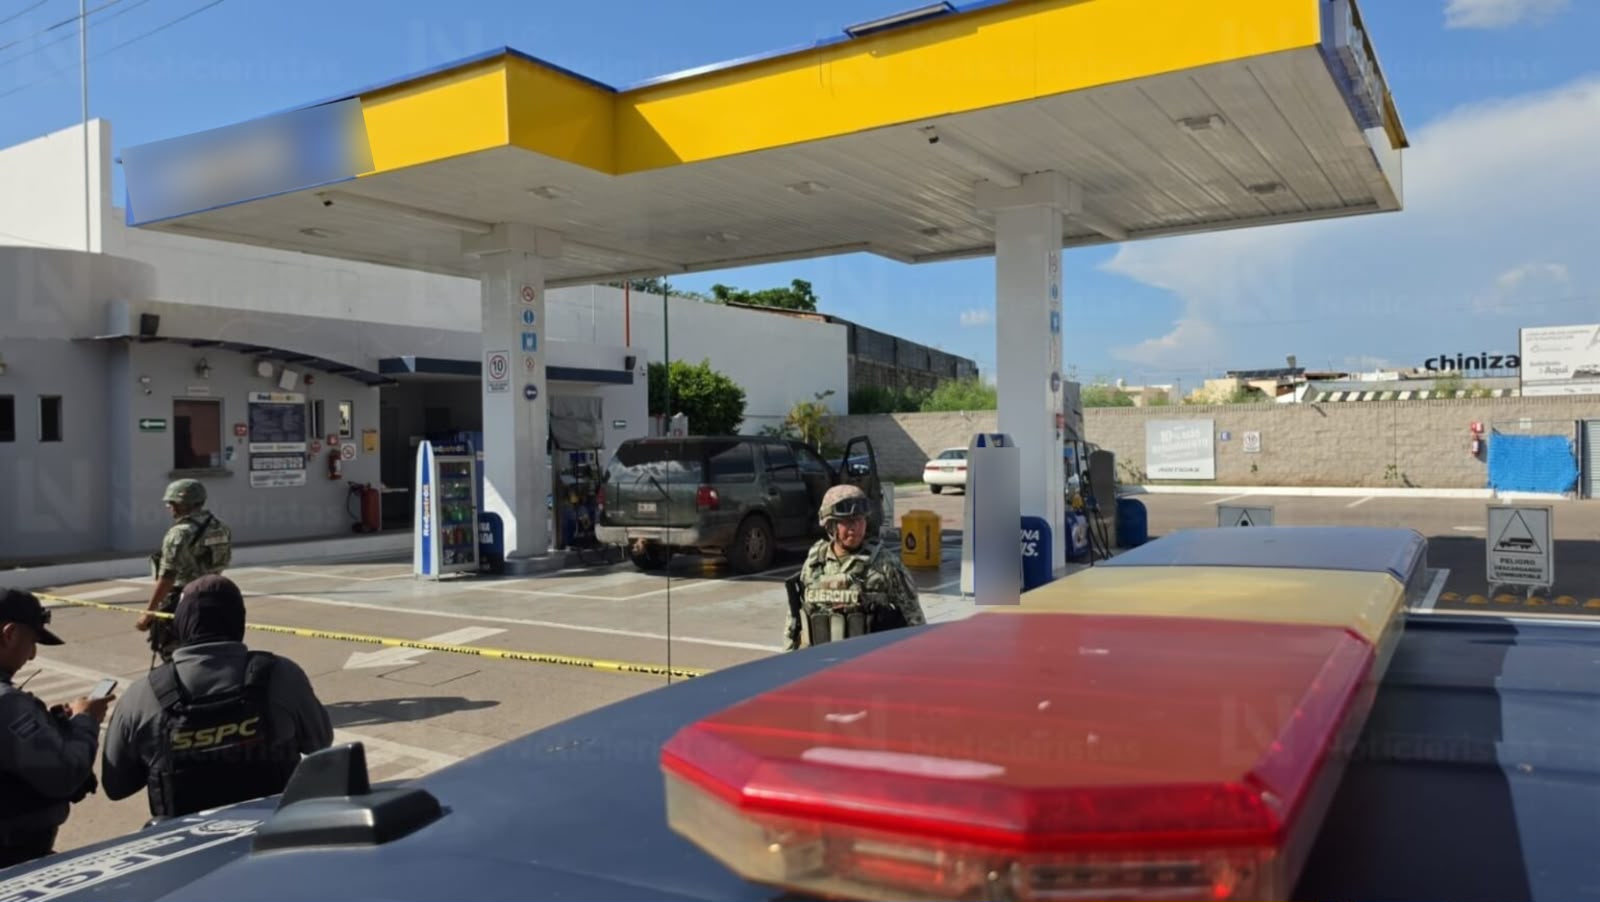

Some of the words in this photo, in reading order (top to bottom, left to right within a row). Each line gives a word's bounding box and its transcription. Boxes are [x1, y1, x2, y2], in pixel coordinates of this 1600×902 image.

[493, 360, 504, 371] 10
[1424, 352, 1520, 372] chiniza
[170, 716, 260, 751] SSPC
